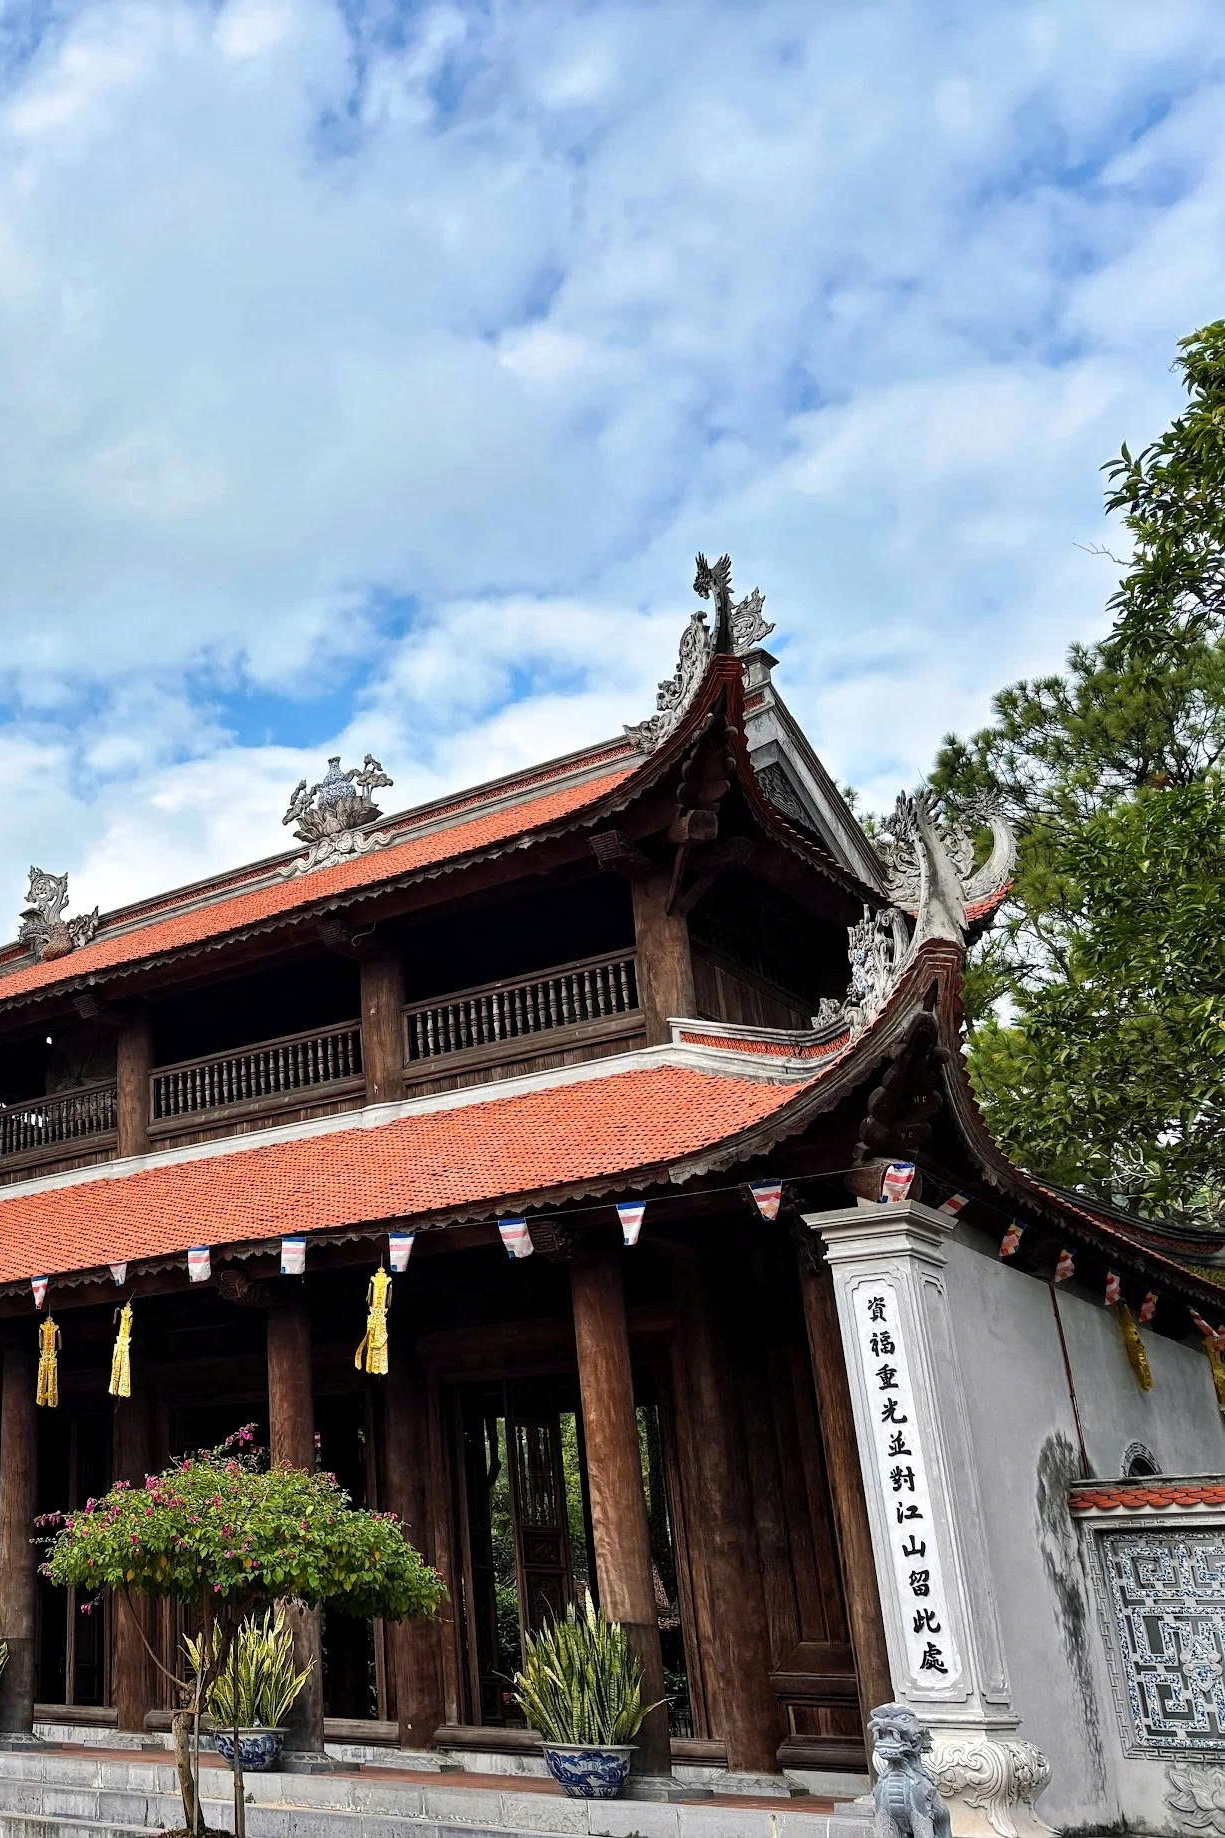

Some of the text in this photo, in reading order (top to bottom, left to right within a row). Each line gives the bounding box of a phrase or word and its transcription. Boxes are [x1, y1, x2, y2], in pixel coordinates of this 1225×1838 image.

[867, 1296, 949, 1674] 資福重光並對江山留此處
